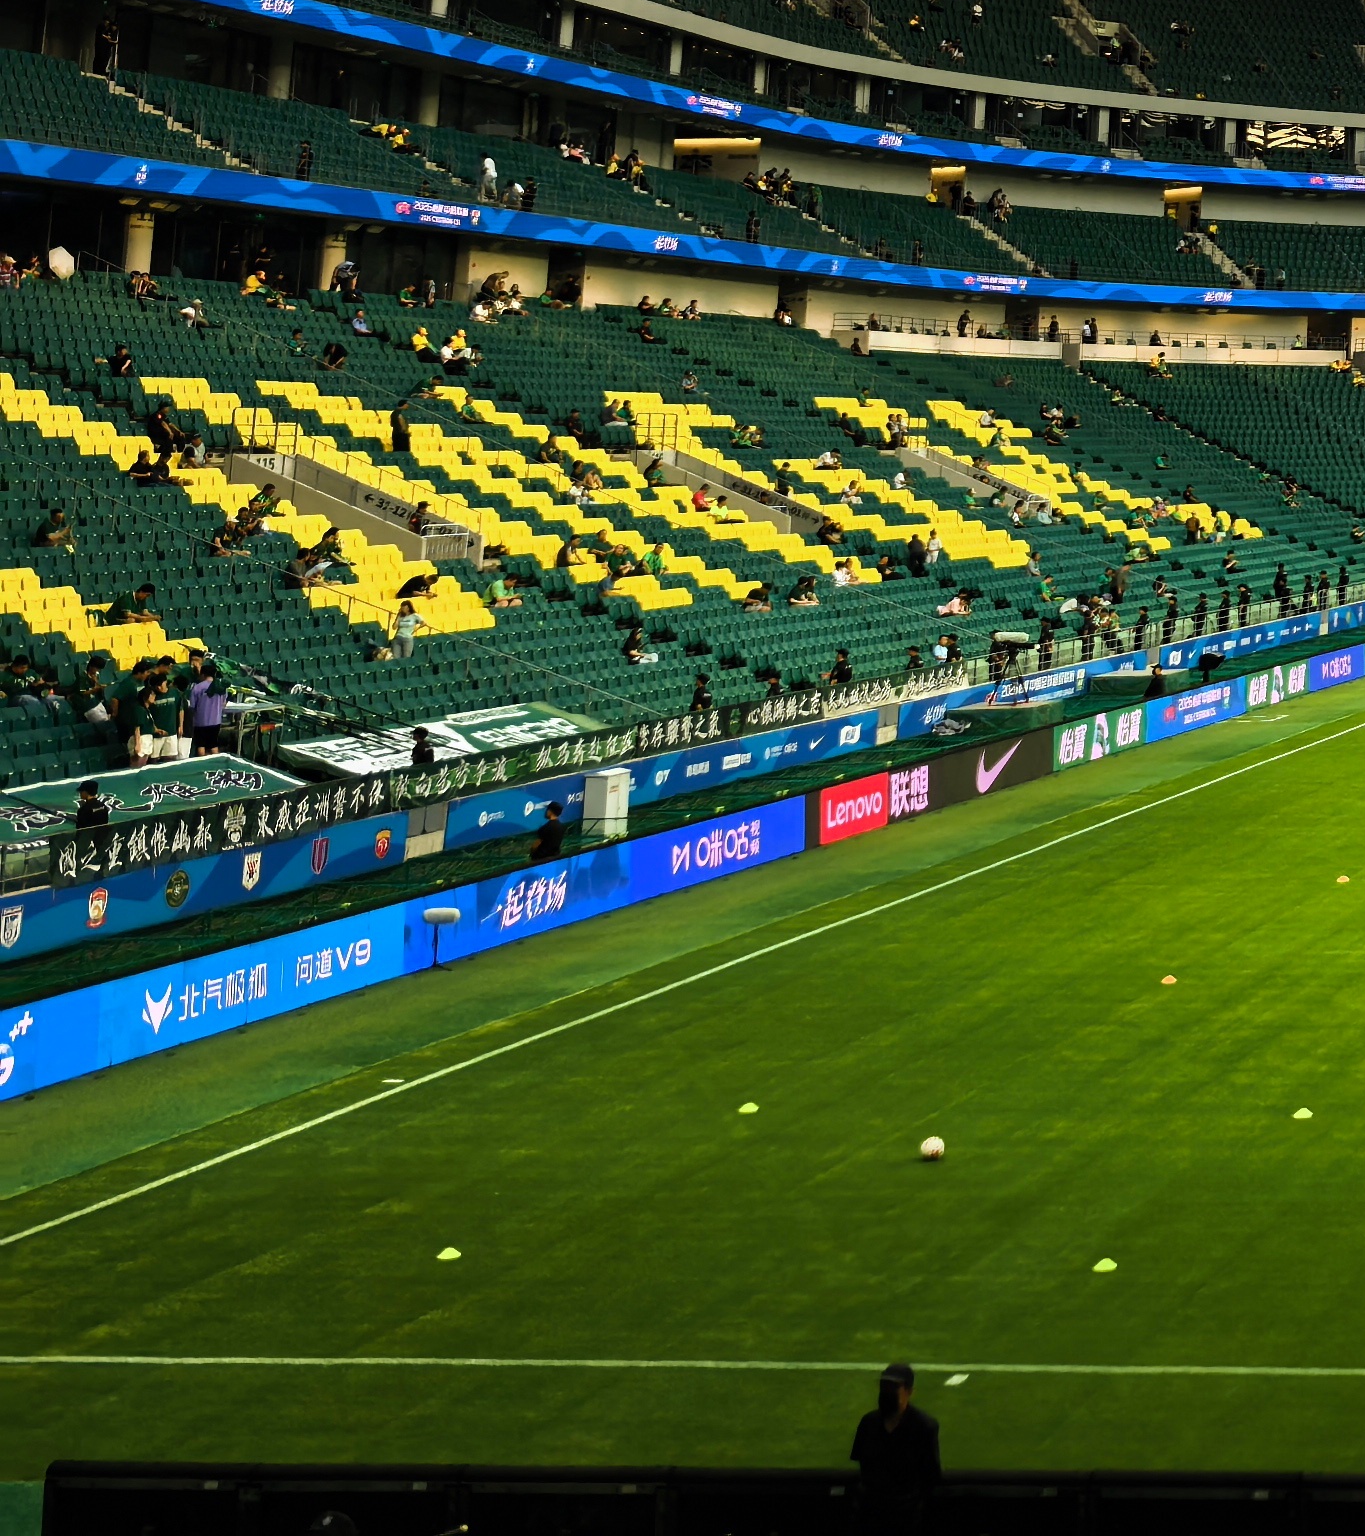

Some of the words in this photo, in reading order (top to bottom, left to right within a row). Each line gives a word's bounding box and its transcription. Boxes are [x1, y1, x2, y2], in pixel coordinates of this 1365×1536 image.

[826, 791, 882, 828] Lenovo
[890, 765, 929, 817] 联想
[481, 870, 567, 931] 一起登场
[179, 962, 267, 1022] 北汽极狐
[296, 938, 371, 987] 问道V9
